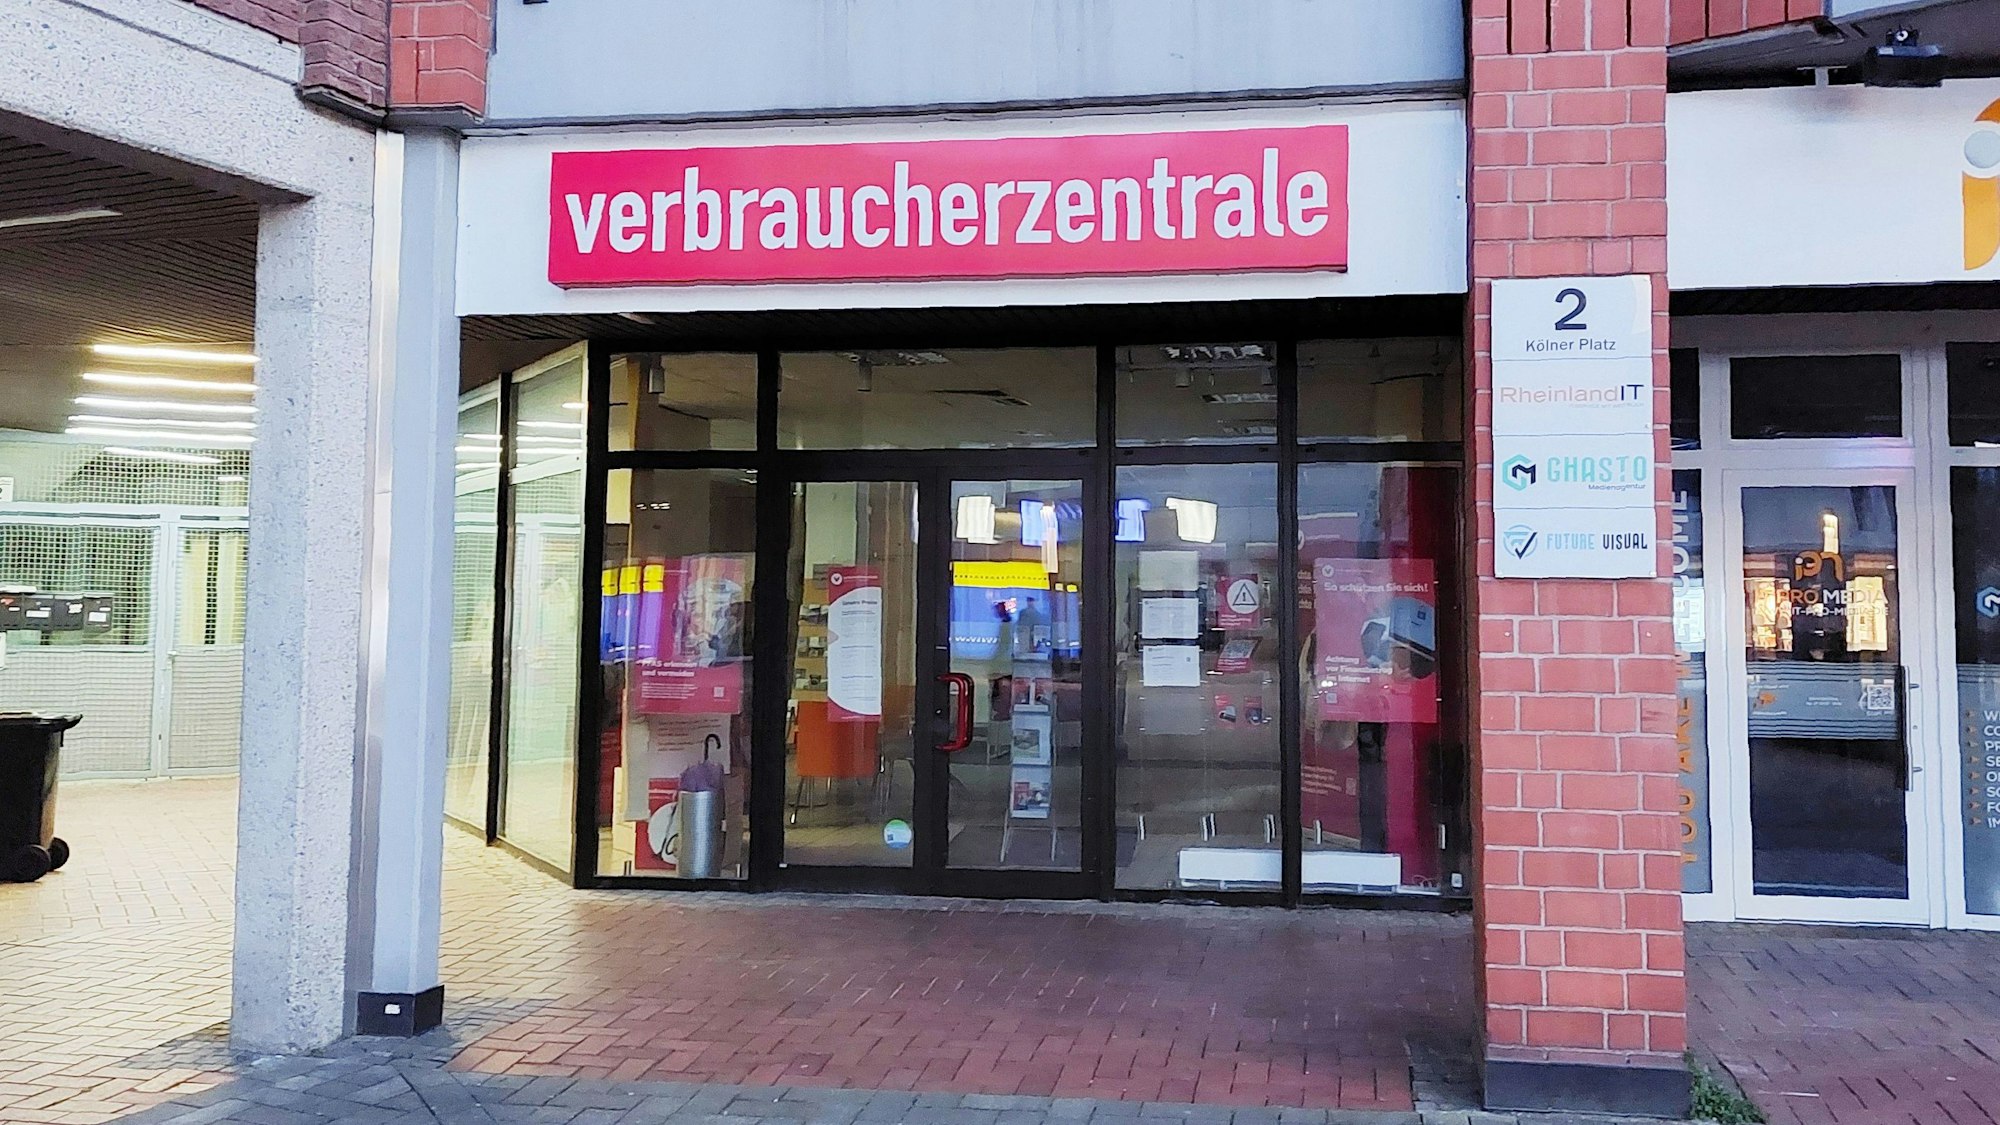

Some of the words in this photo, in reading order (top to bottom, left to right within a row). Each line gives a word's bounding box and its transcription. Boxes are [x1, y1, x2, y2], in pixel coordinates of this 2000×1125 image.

[565, 147, 1330, 255] verbraucherzentrale
[1555, 288, 1587, 331] 2
[1526, 339, 1575, 352] Kölner
[1579, 338, 1617, 351] Platz
[1500, 384, 1645, 403] RheinlandIT
[1547, 456, 1647, 482] GHASTO
[1547, 533, 1595, 550] FUTURE
[1603, 533, 1648, 550] VISUAL
[1823, 589, 1888, 604] MEDIA
